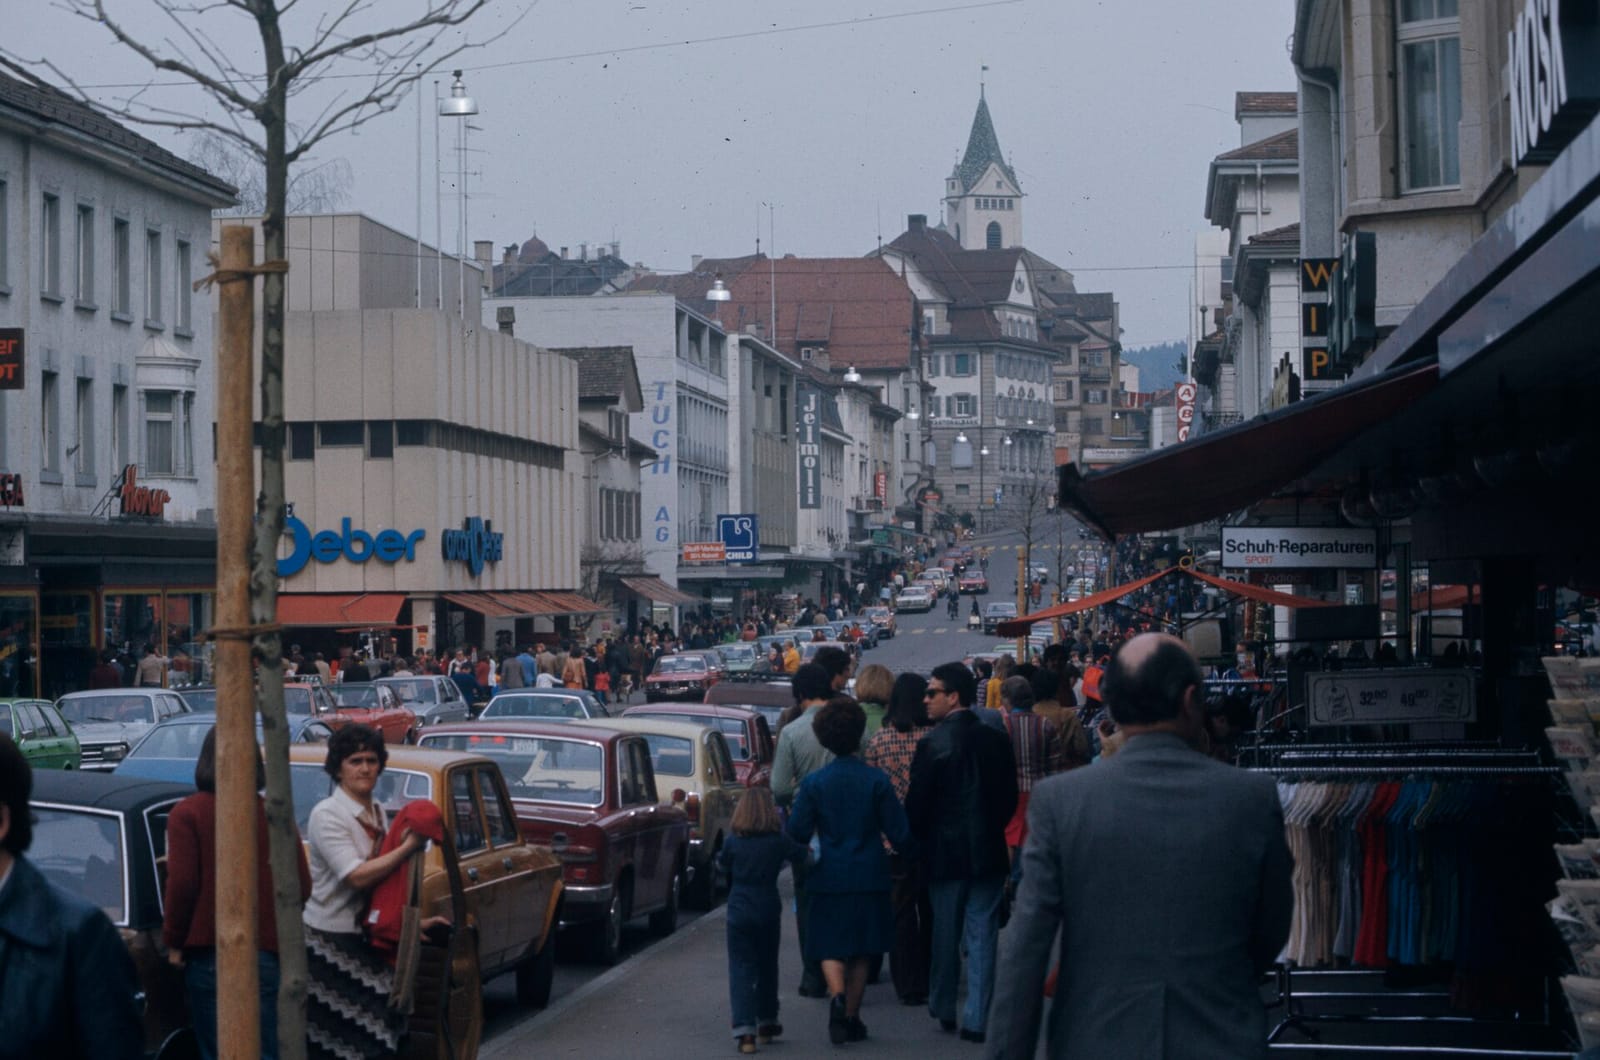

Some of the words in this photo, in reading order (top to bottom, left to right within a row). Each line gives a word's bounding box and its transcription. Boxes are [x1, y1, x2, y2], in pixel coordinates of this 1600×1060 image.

[652, 381, 671, 475] TUCH
[800, 394, 819, 505] Jelmoli
[655, 505, 671, 542] AG
[1244, 555, 1273, 565] SPORT
